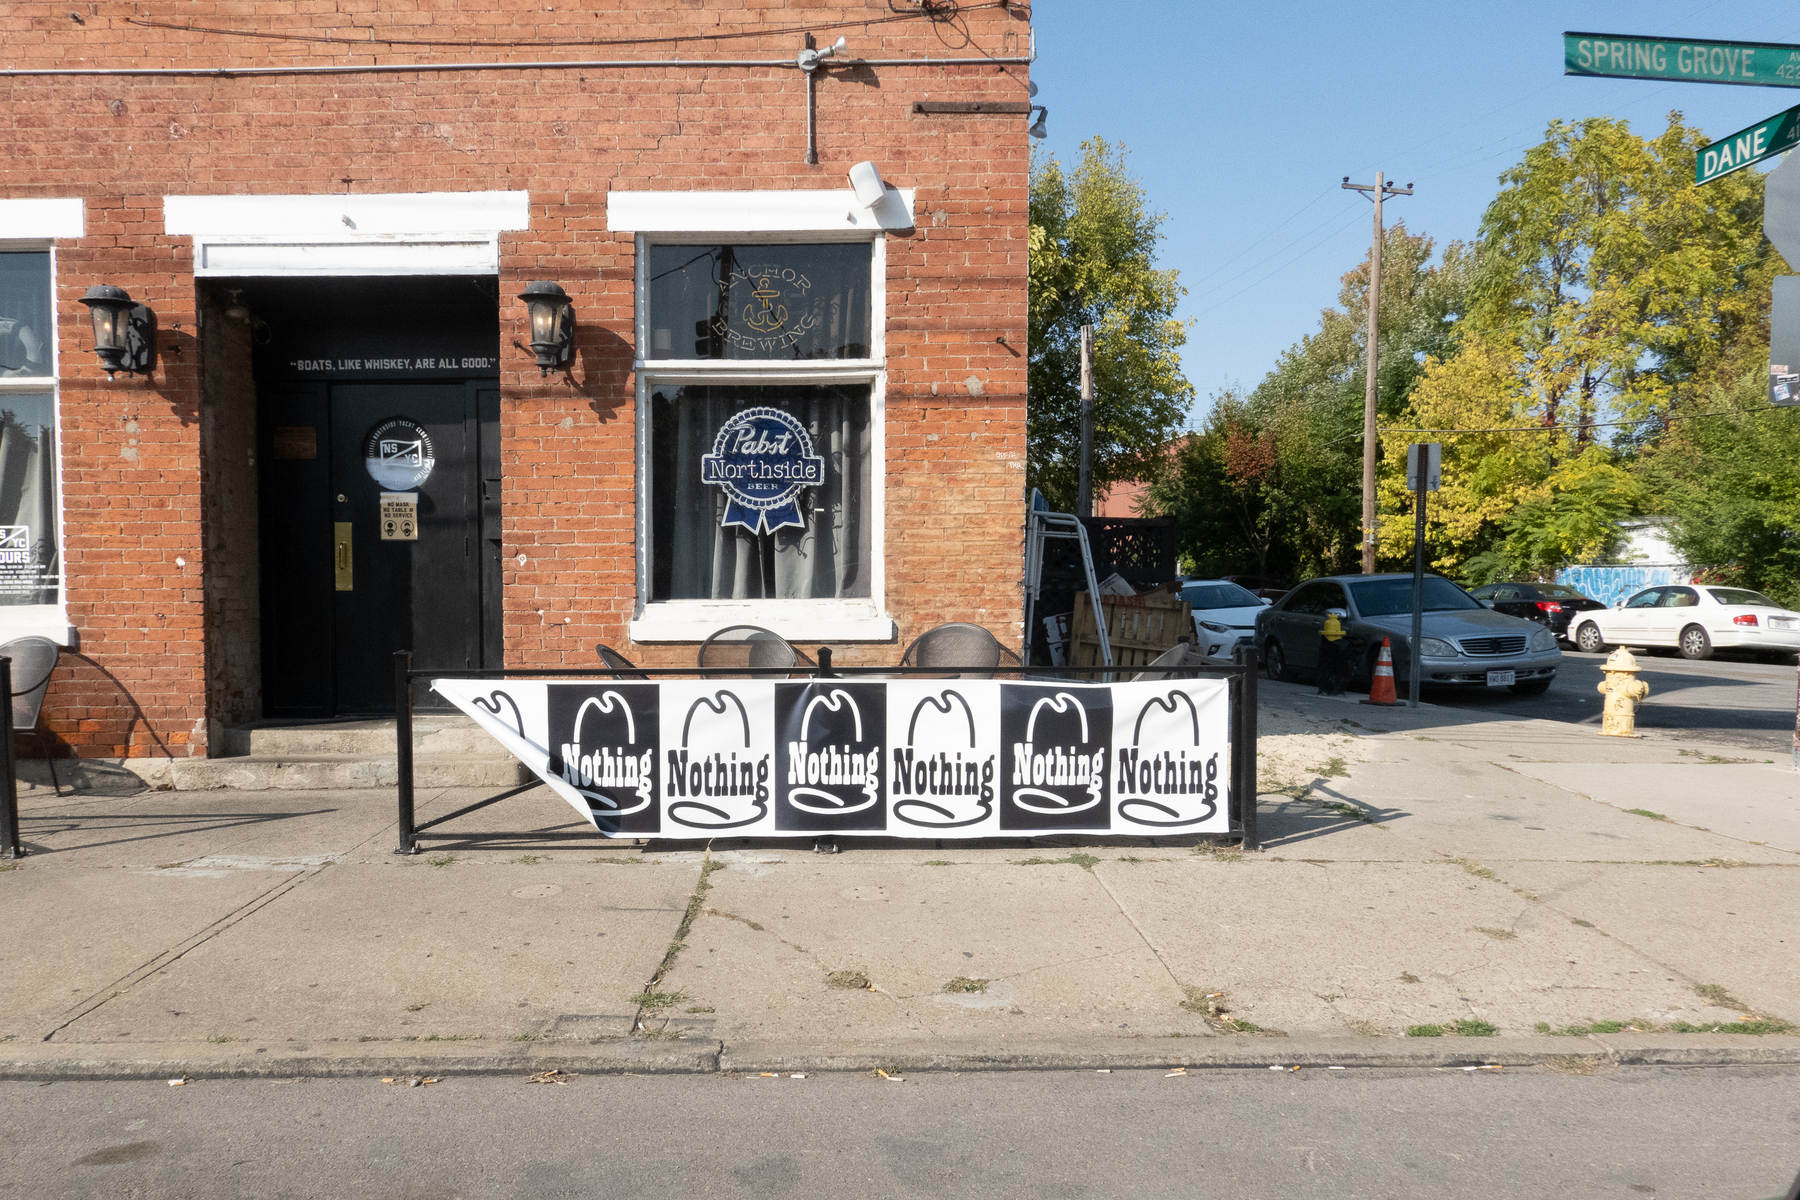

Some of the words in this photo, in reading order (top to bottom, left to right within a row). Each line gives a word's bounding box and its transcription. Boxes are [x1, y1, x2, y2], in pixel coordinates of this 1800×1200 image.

[1577, 39, 1667, 72] SPRING
[1677, 45, 1756, 78] GROVE
[1703, 126, 1768, 178] DANE
[718, 264, 812, 297] ANCHOR
[712, 313, 816, 351] BREWING
[338, 359, 361, 370] LIKE
[364, 358, 413, 371] WHISKEY,
[415, 358, 436, 369] ARE
[438, 358, 459, 369] ALL
[372, 421, 397, 441] NORTHSIDE
[398, 421, 416, 429] YACHT
[415, 426, 428, 439] CLUB
[383, 443, 398, 454] NS
[731, 423, 793, 455] Pabst
[404, 453, 418, 464] YC
[709, 459, 817, 479] Northside
[12, 538, 26, 547] YC
[561, 743, 653, 796] Nothing
[667, 749, 770, 804] Nothing
[788, 741, 879, 794] Nothing
[893, 747, 995, 804] Nothing
[1012, 743, 1104, 793] Nothing
[1117, 747, 1219, 804] Nothing
